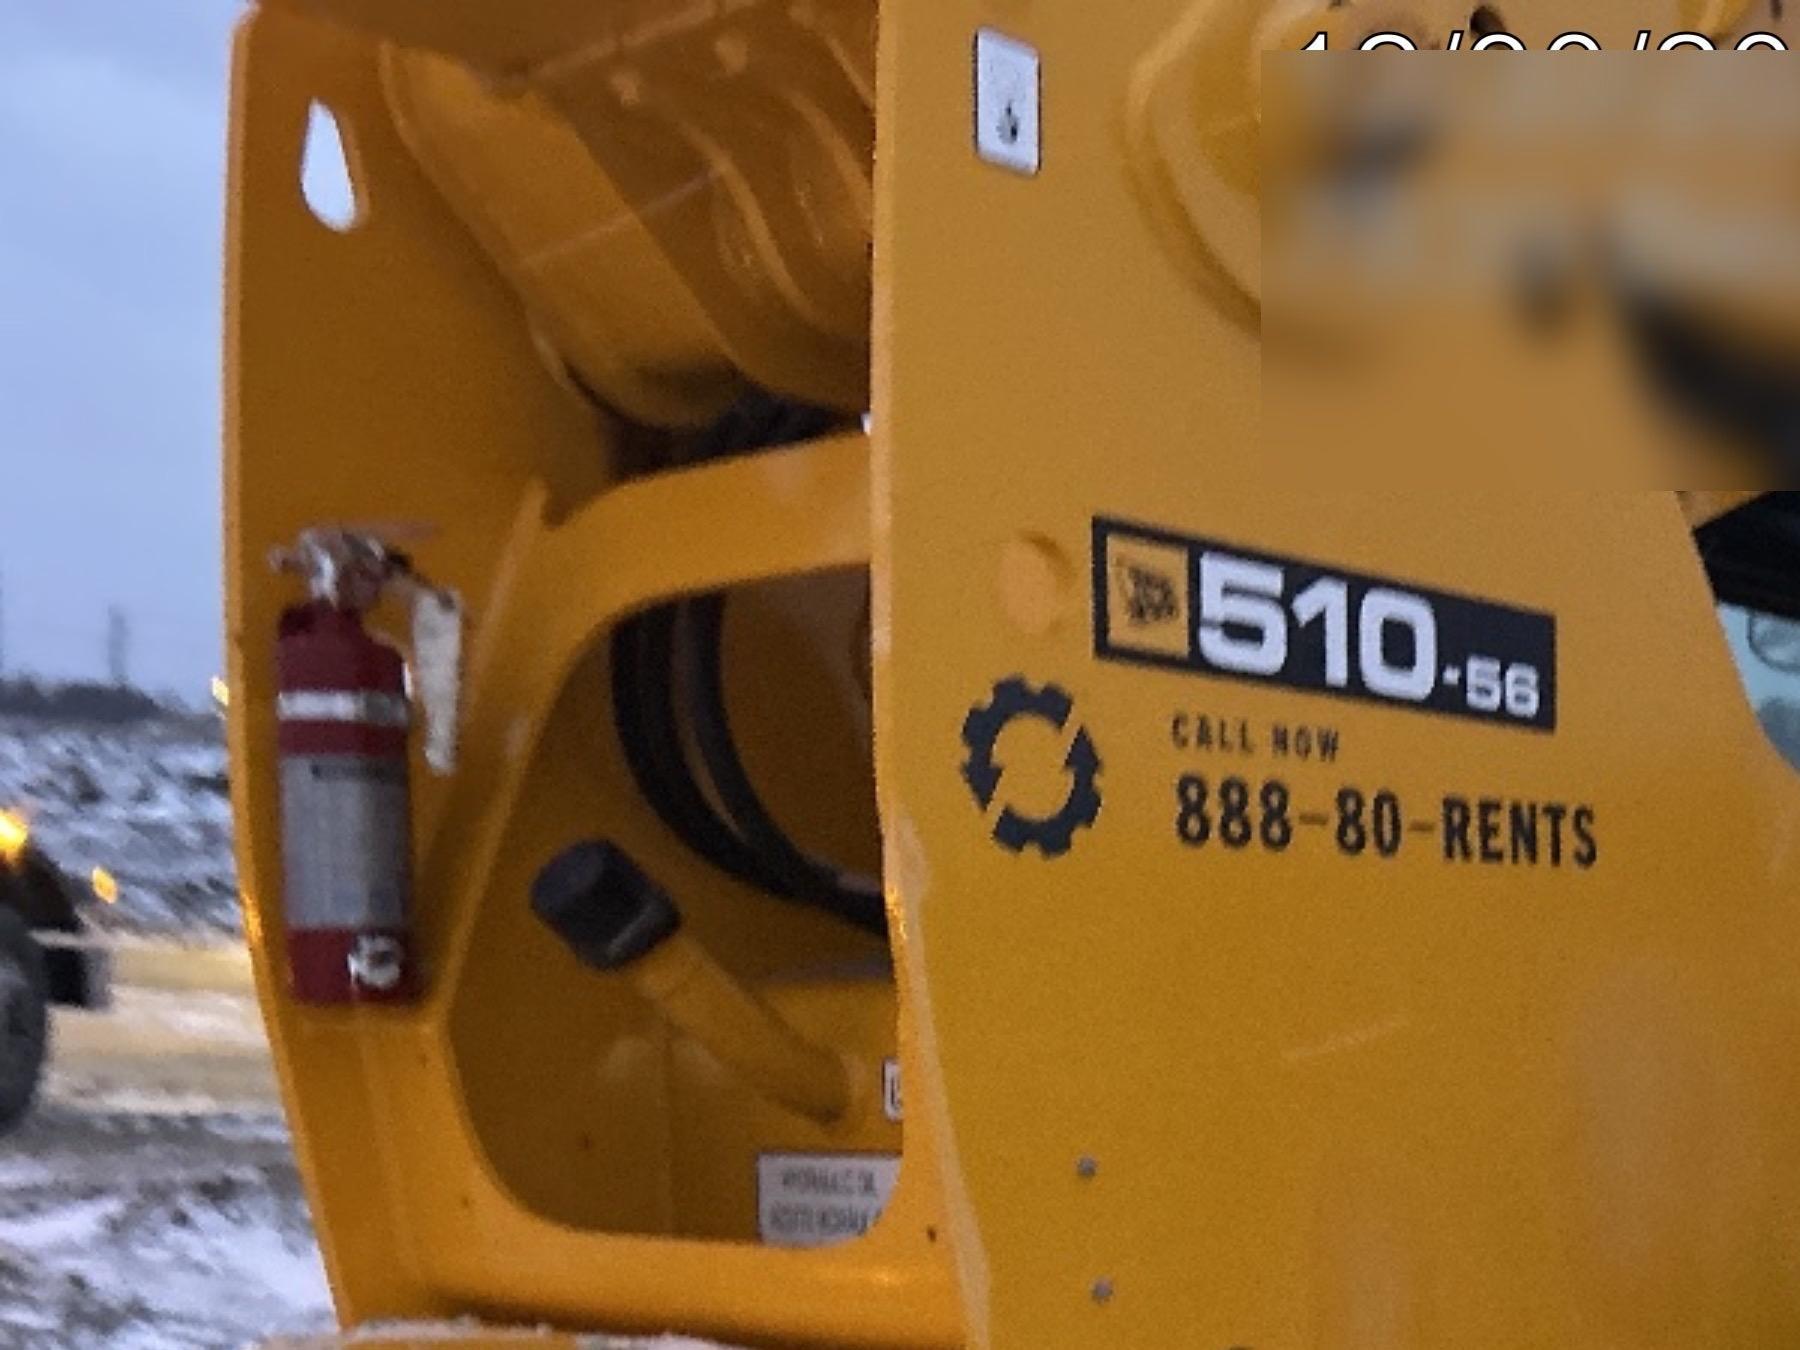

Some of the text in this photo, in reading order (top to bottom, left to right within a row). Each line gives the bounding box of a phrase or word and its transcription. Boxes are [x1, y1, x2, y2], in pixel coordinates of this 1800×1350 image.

[1172, 713, 1339, 762] CALL NOW
[1176, 774, 1597, 868] 888-80-RENTS
